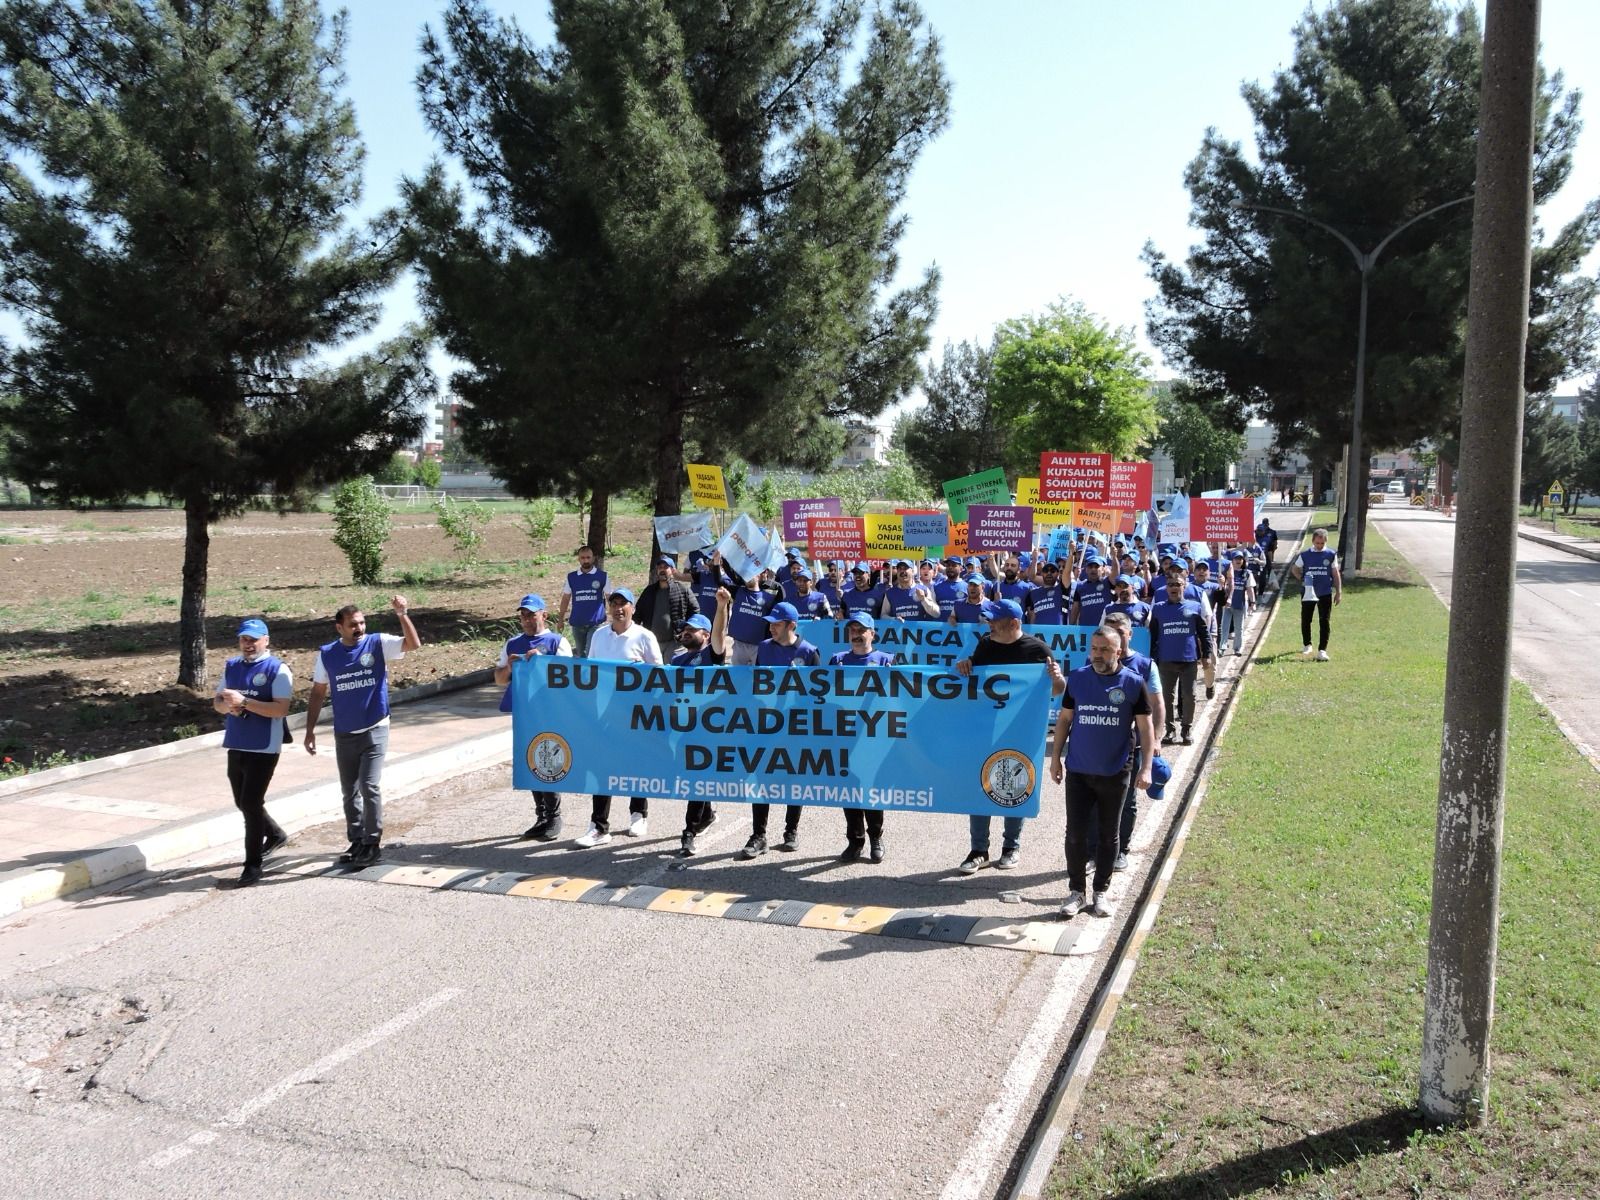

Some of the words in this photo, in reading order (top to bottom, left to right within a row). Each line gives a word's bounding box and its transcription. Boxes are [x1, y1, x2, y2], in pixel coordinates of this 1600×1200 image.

[1050, 457, 1076, 465] ALIN
[1079, 455, 1101, 466] TERİ
[1046, 467, 1105, 477] KUTSALDIR
[1110, 465, 1137, 473] ŞASIN
[1045, 477, 1105, 488] SÖMÜRÜYE
[1110, 482, 1137, 490] ŞASIN
[1046, 489, 1077, 500] GEÇİT
[1080, 491, 1103, 500] YOK
[799, 503, 825, 511] ZAFER
[1205, 500, 1239, 508] YAŞASIN
[987, 510, 1015, 518] ZAFER
[815, 520, 836, 528] ALIN
[837, 519, 857, 529] TERİ
[980, 518, 1021, 528] DİRENEN
[1081, 519, 1103, 529] YOK!
[1205, 516, 1239, 524] YAŞASIN
[877, 524, 903, 533] YAŞAS
[975, 528, 1026, 539] EMEKÇİNİN
[812, 530, 861, 538] KUTSALDIR
[1206, 532, 1238, 540] DİRENİŞ
[812, 538, 862, 548] SÖMÜRÜYE
[982, 539, 1019, 547] OLACAK
[815, 549, 841, 559] GEÇİT
[841, 551, 861, 559] YOK
[867, 559, 884, 568] EÇİT
[336, 678, 376, 692] SENDİKASI
[547, 663, 599, 691] BU
[615, 666, 738, 695] DAHA
[752, 669, 1011, 709] BAŞLANGIÇ
[1078, 704, 1119, 713] petrol-iş
[630, 698, 907, 738] MÜCADELEYE
[1078, 714, 1120, 726] SENDİKASI
[685, 744, 849, 777] DEVAM!
[608, 775, 671, 795] PETROL
[675, 775, 690, 796] İŞ
[694, 777, 786, 800] SENDİKASI
[791, 784, 864, 804] BATMAN
[868, 787, 933, 808] ŞUBESİ
